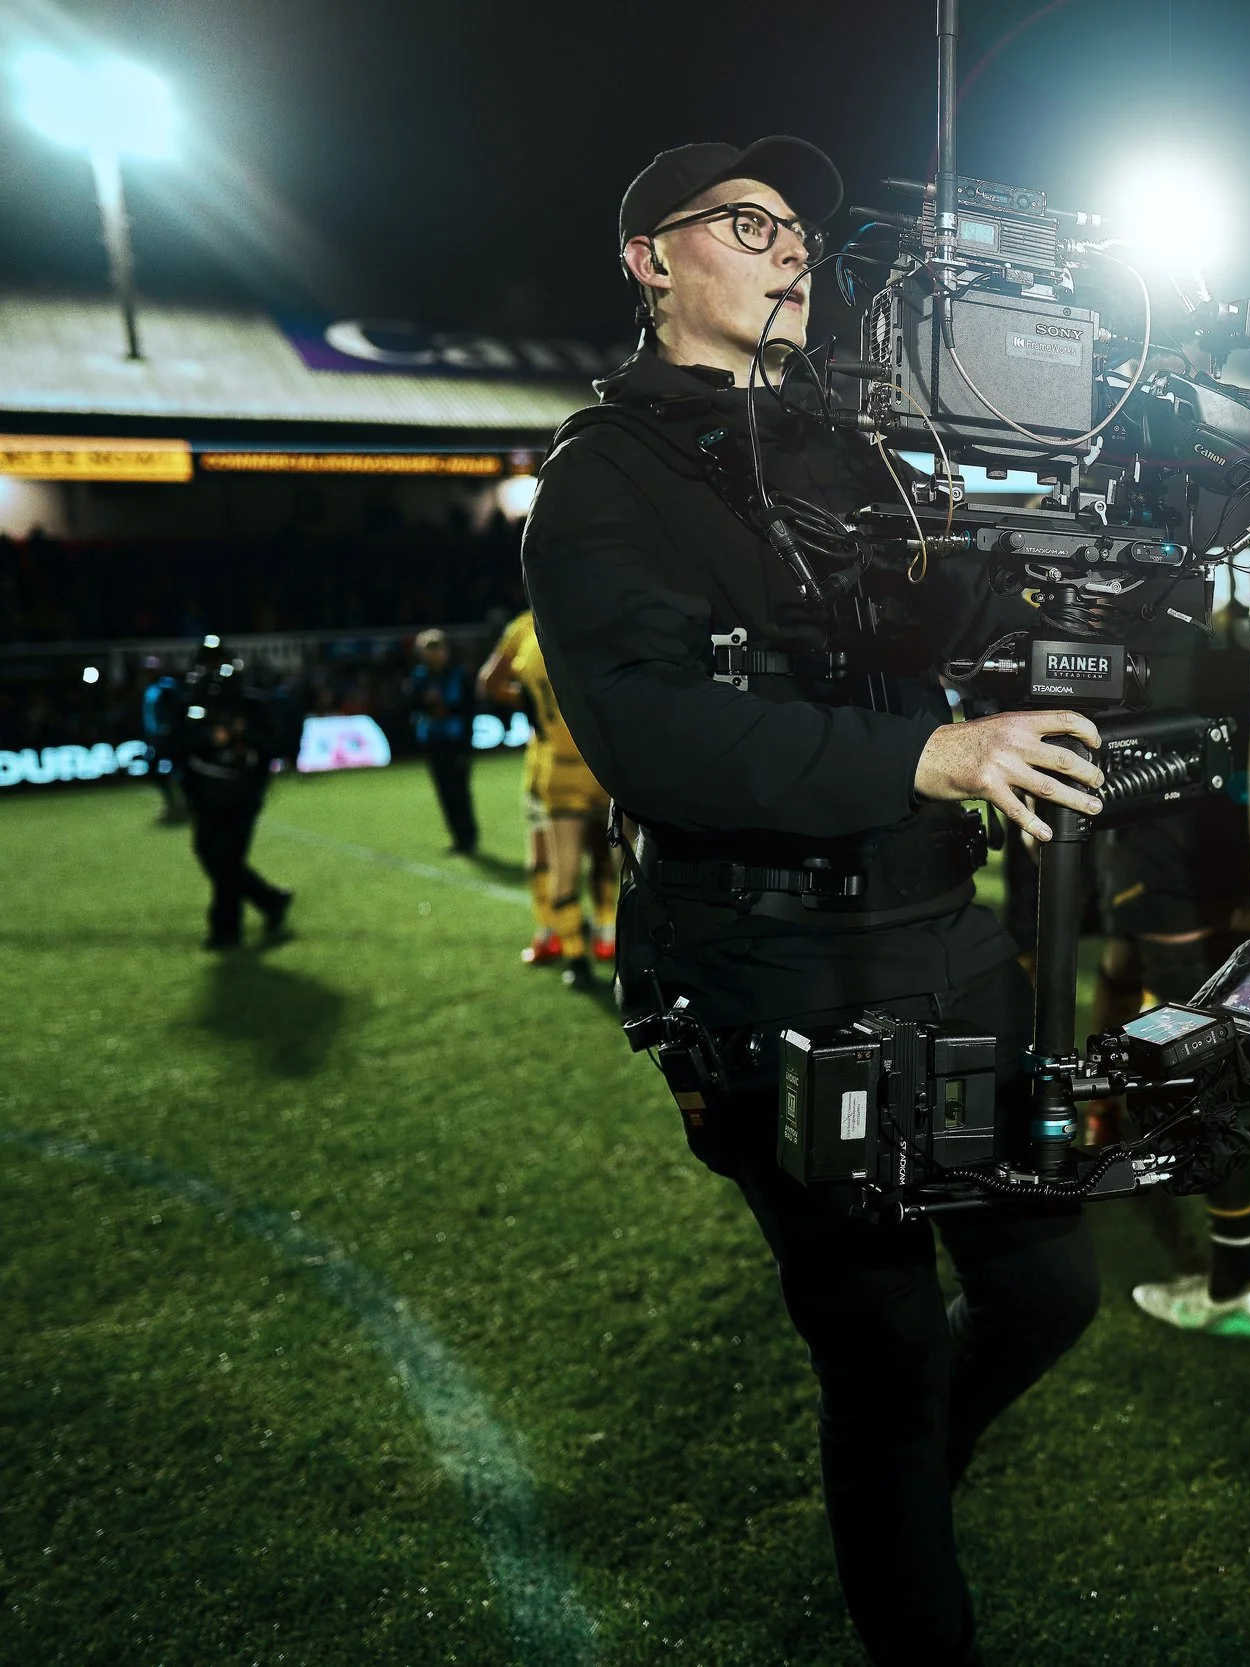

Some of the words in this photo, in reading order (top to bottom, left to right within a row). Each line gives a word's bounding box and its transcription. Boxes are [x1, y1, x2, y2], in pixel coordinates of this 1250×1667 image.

[1035, 323, 1083, 340] SONY
[1193, 443, 1226, 466] Canon
[1048, 655, 1108, 672] RAINER
[1053, 671, 1103, 679] STEADICAM
[1108, 738, 1139, 750] STEADICAM
